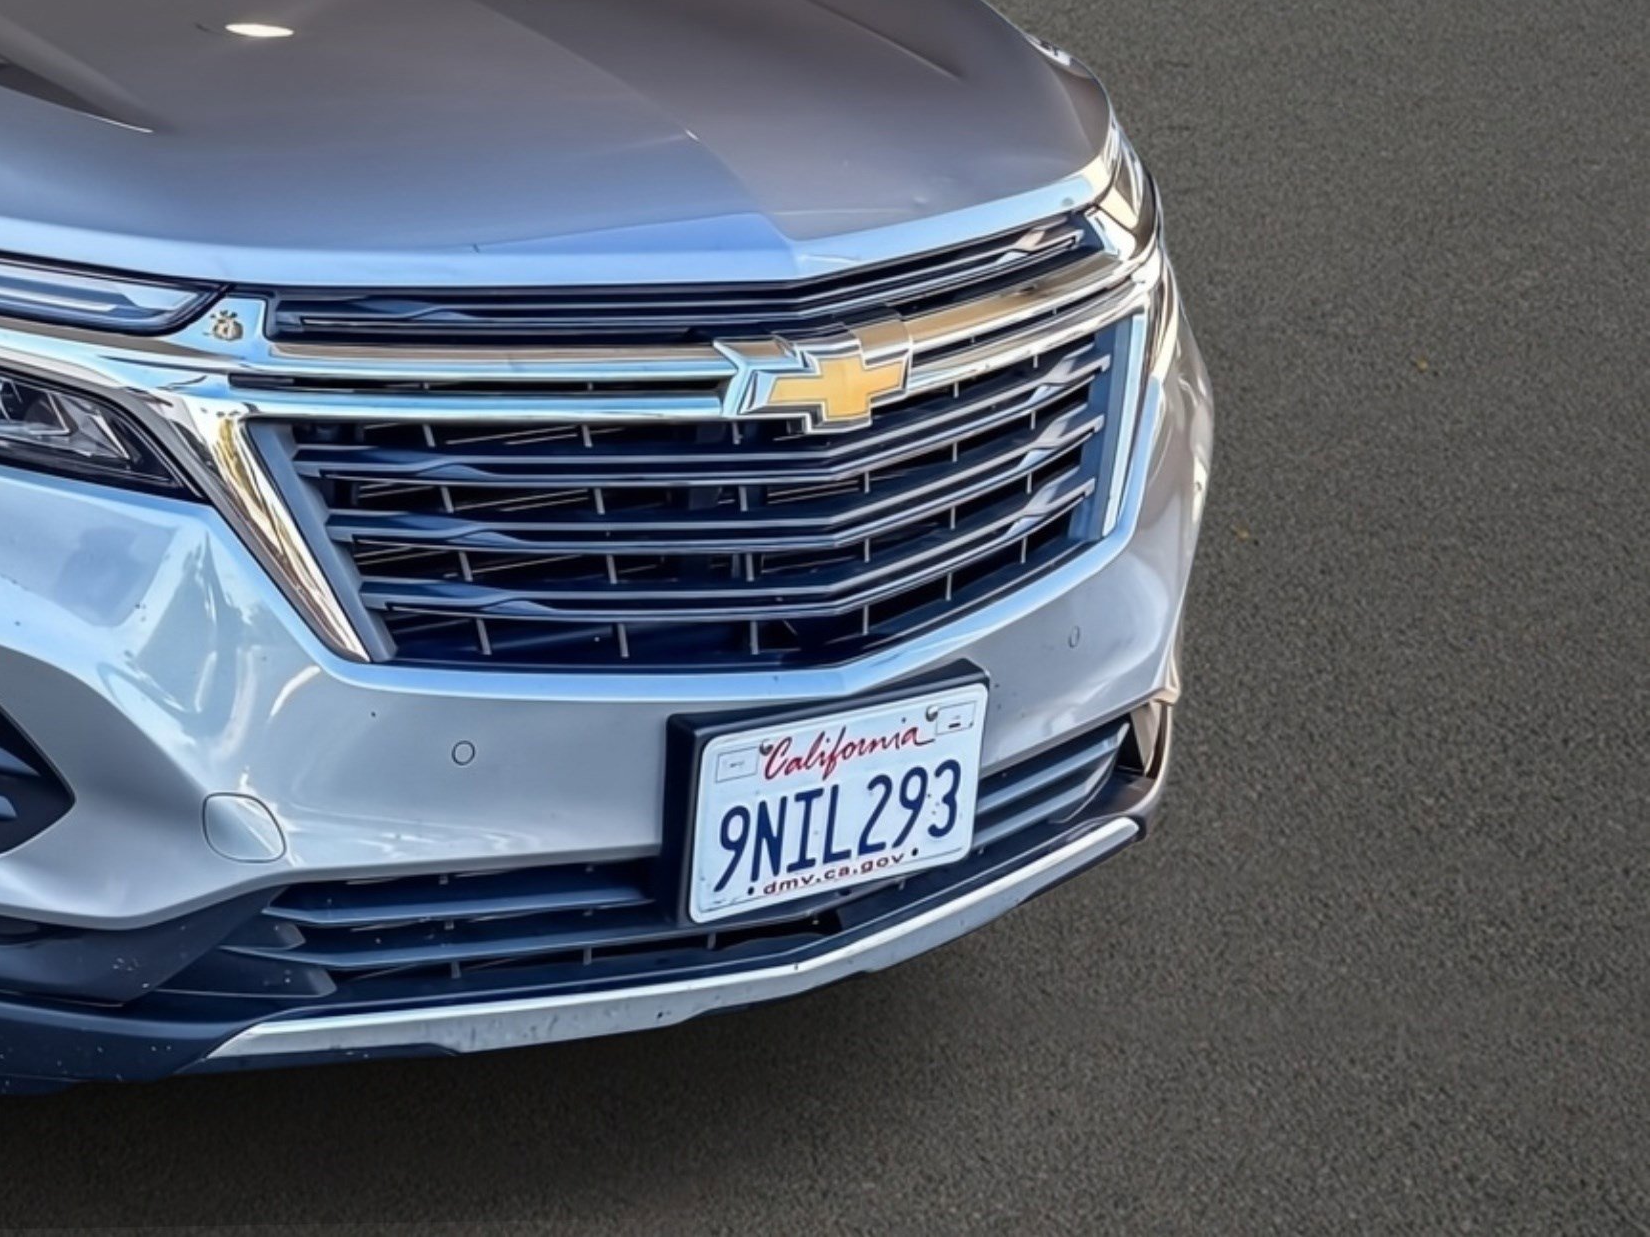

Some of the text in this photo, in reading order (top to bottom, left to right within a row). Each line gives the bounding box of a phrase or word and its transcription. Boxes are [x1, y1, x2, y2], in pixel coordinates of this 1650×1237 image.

[763, 725, 936, 781] California
[713, 759, 961, 893] 9NIL293
[762, 852, 906, 896] dmv.ca.gov
